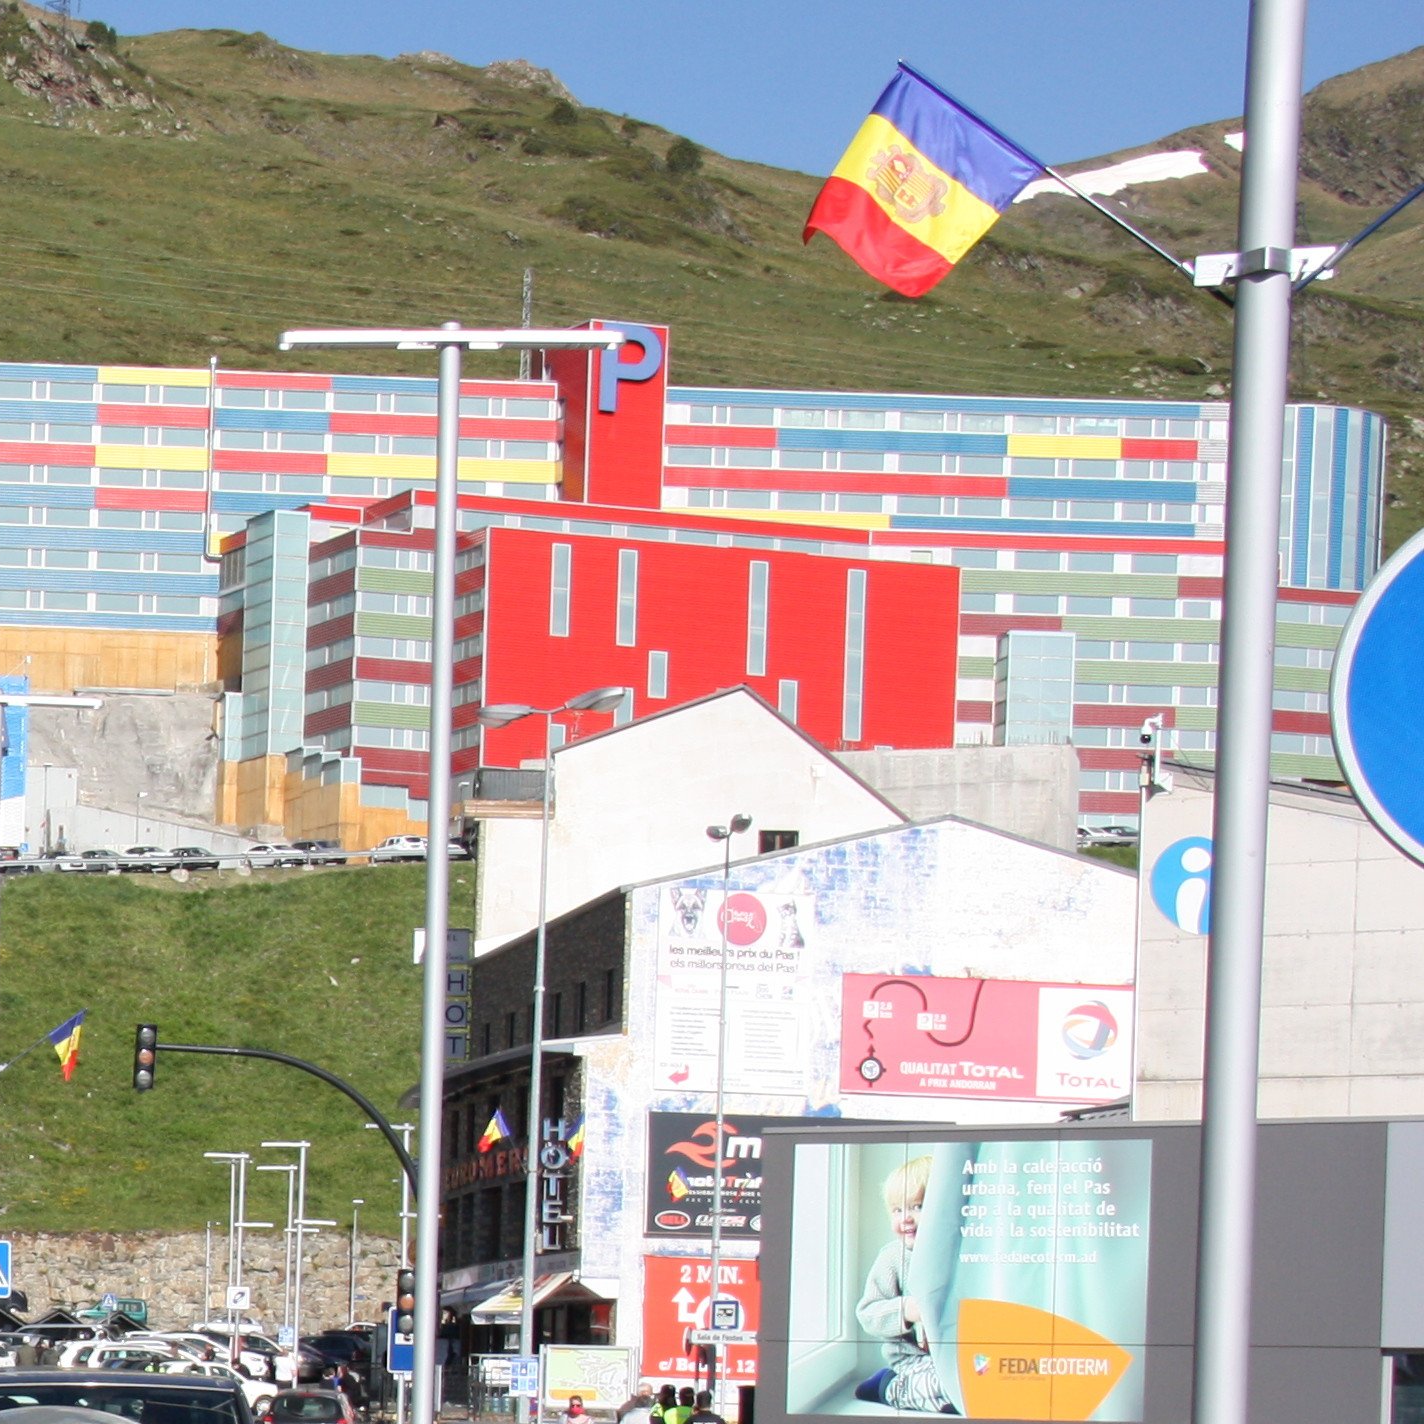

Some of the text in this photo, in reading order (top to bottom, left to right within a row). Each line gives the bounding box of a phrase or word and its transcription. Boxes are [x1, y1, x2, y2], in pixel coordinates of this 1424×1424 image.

[759, 949, 773, 959] du
[775, 950, 794, 960] Pas
[900, 1061, 957, 1076] QUALITAT
[1057, 1072, 1121, 1089] TOTAL
[962, 1157, 1102, 1174] Amb la calefacció
[541, 1117, 568, 1250] HOTEL
[962, 1180, 1111, 1196] urbana, fem el Pas
[960, 1203, 988, 1218] cap
[1007, 1202, 1022, 1216] la
[1026, 1201, 1091, 1219] qualitat
[1096, 1201, 1117, 1216] de
[960, 1223, 993, 1238] vida
[1009, 1223, 1024, 1238] la
[1028, 1222, 1140, 1238] sostenibilitat
[959, 1251, 1098, 1265] www.fedaecoterm.ad
[680, 1264, 743, 1284] 2 MIN.
[737, 1360, 755, 1373] 12
[999, 1358, 1109, 1376] FEDAECOTERM
